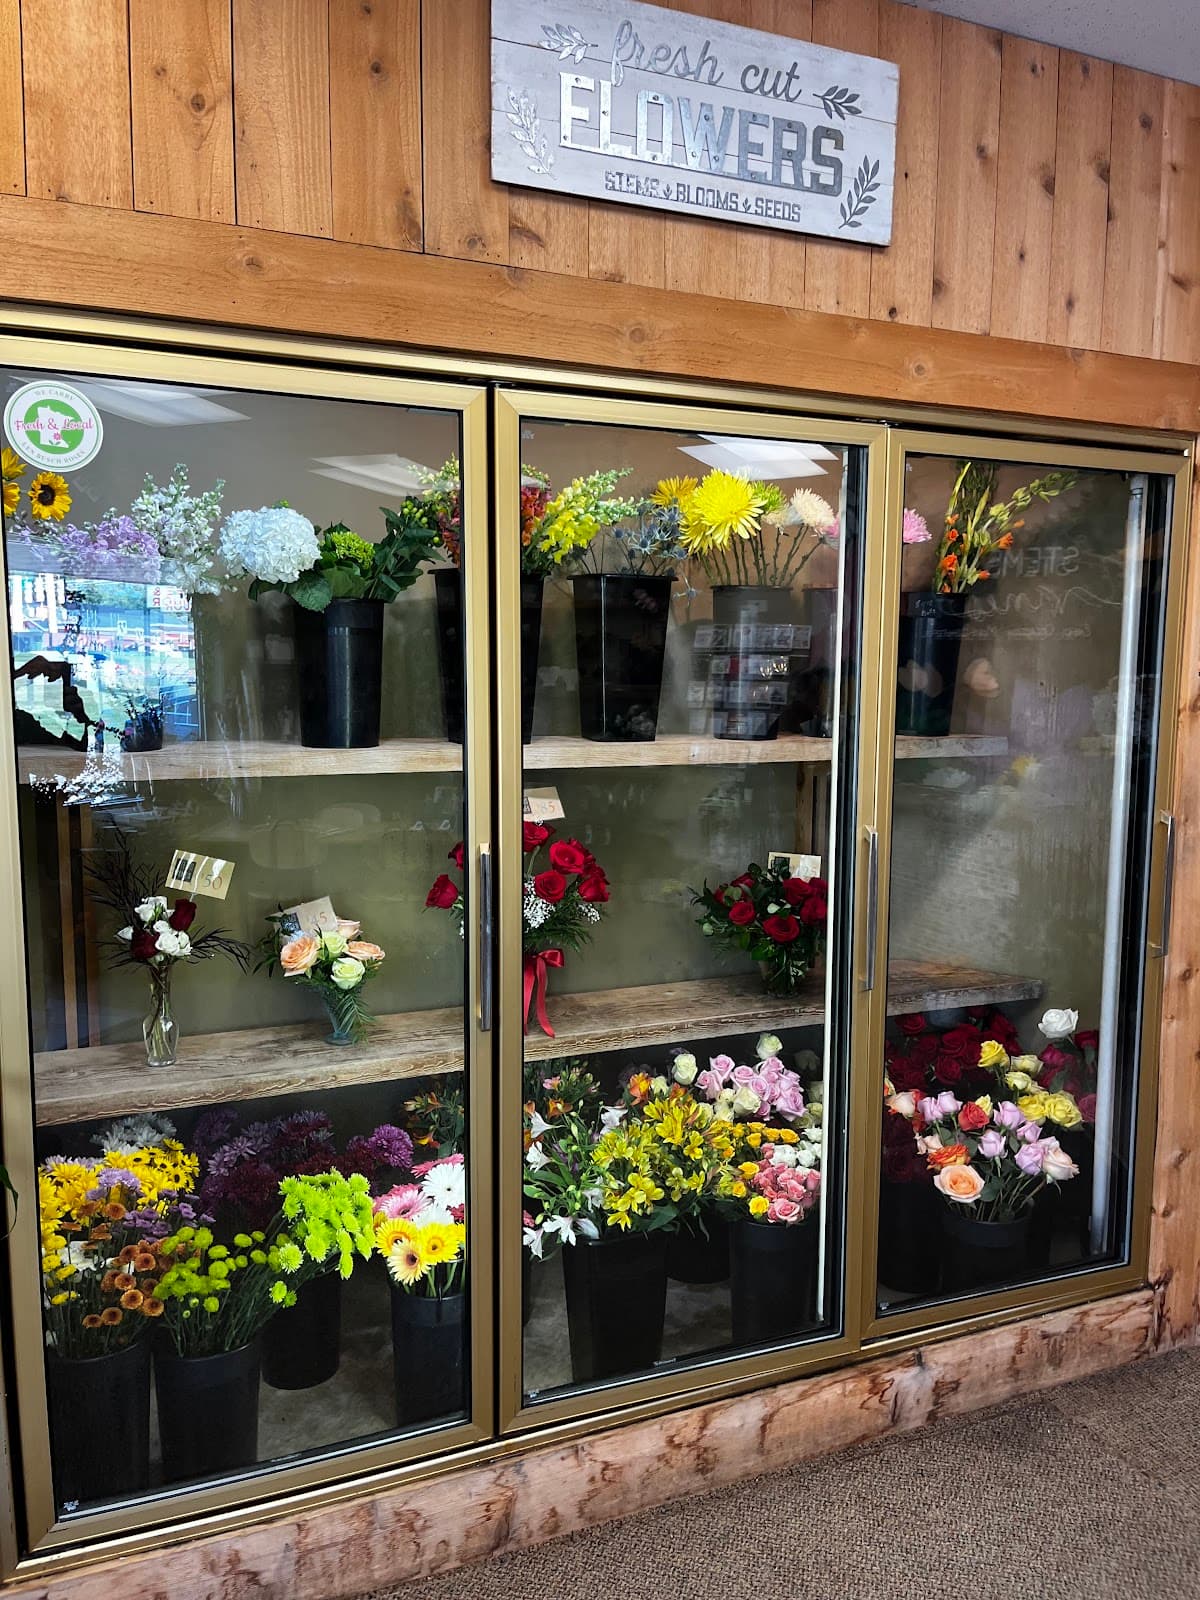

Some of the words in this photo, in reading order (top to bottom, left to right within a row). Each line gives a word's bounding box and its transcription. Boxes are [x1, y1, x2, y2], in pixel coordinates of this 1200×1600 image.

[610, 19, 724, 87] fresh
[740, 61, 803, 103] cut
[558, 71, 845, 198] FLOWERS
[604, 170, 660, 199] STEMS
[675, 182, 739, 213] BLOOMS
[754, 196, 801, 223] SEEDS
[15, 419, 44, 431] Fresh
[47, 417, 59, 430] &
[62, 417, 94, 430] Local
